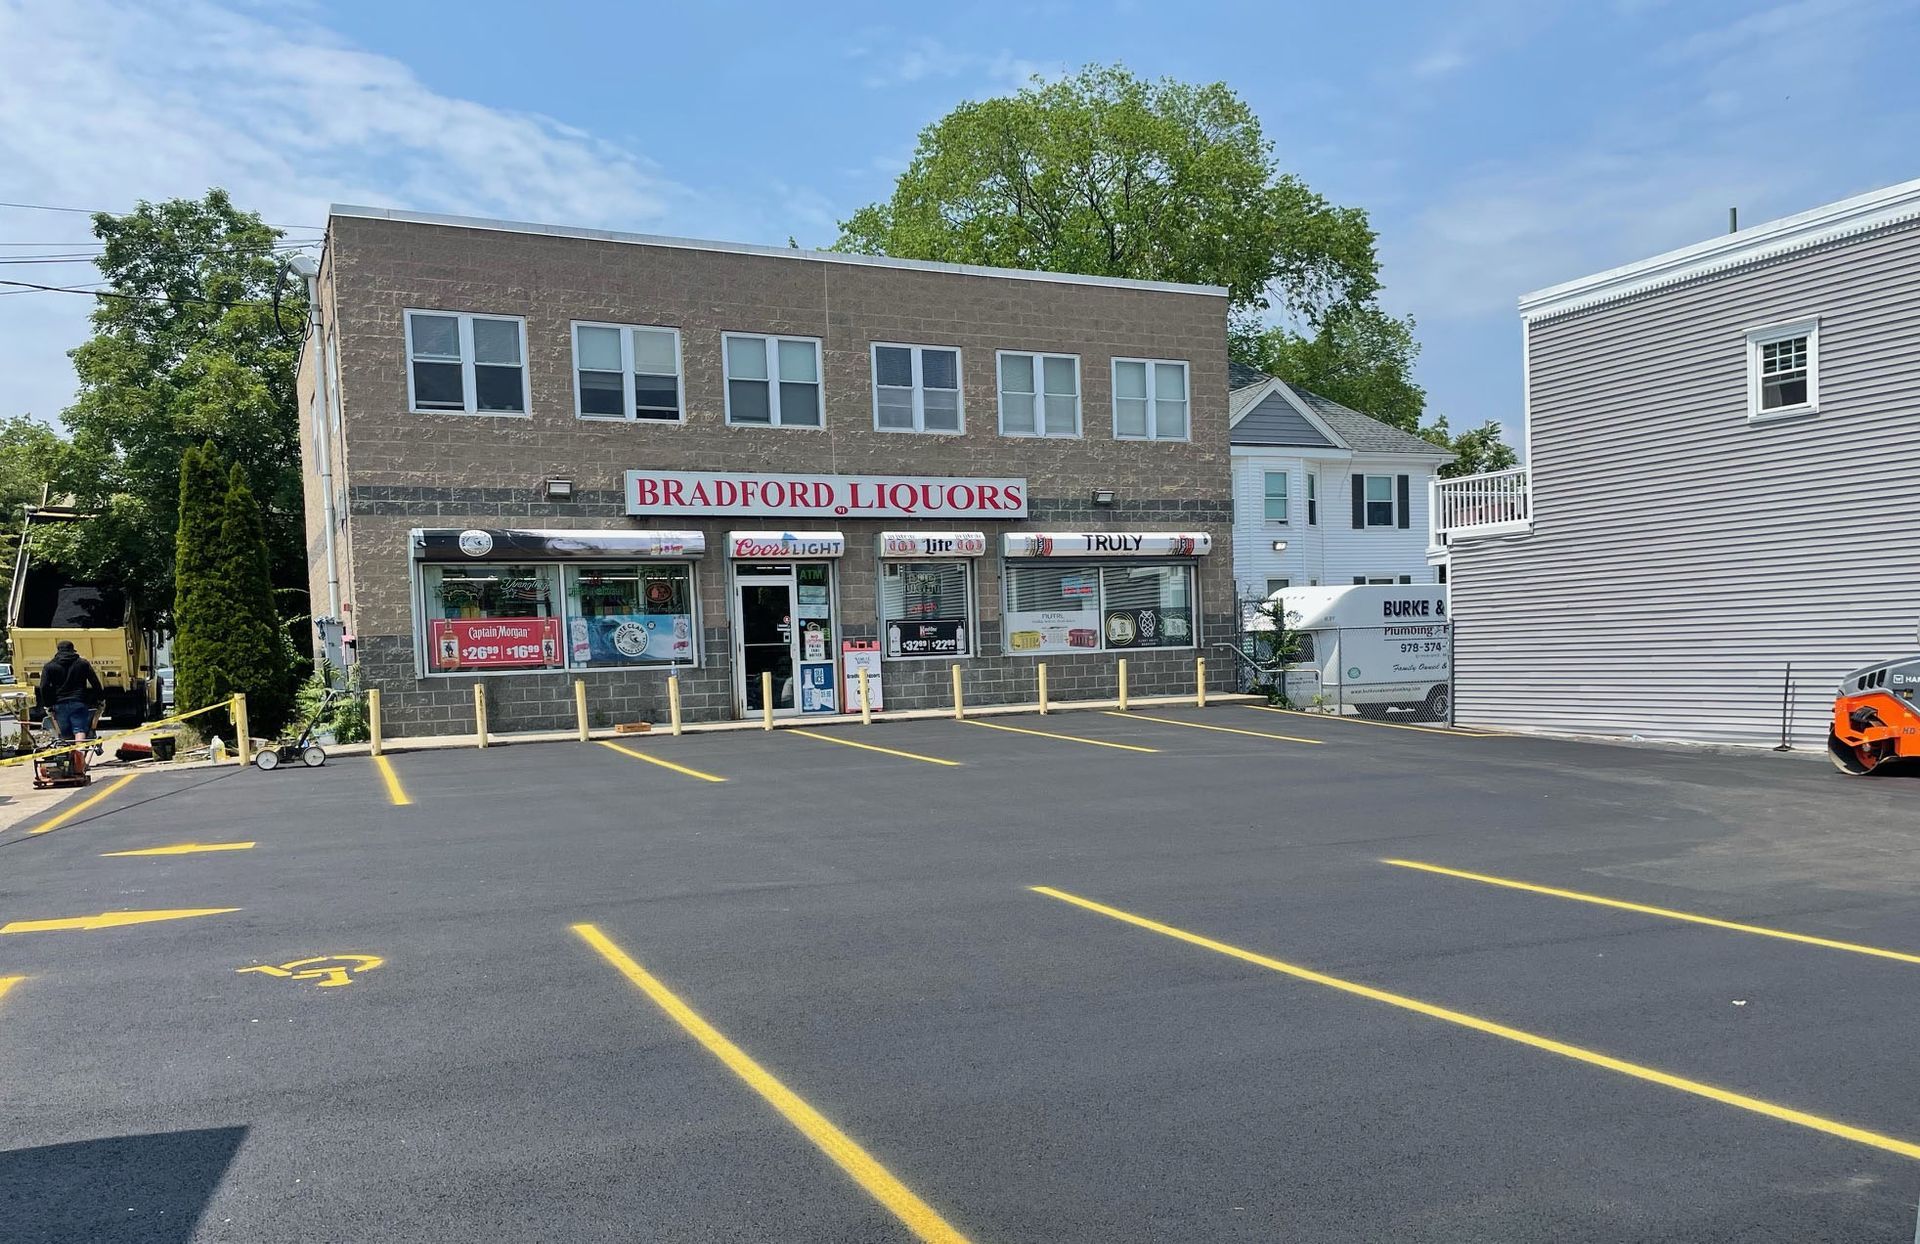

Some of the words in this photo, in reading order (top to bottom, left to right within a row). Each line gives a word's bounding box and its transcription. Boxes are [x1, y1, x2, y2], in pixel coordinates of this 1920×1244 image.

[637, 478, 835, 508] BRADFORD
[848, 482, 1022, 513] LIQUORS
[735, 538, 791, 557] Coors
[791, 541, 841, 556] LIGHT
[923, 538, 953, 555] Lite
[1081, 534, 1143, 551] TRULY
[800, 569, 823, 580] ATM
[1383, 600, 1430, 617] BURKE
[1435, 599, 1445, 616] &
[468, 625, 498, 640] Captain
[497, 625, 528, 640] Morgan
[627, 623, 645, 634] CLAW
[1384, 626, 1433, 637] Plumbing
[1400, 642, 1447, 653] 978-374-
